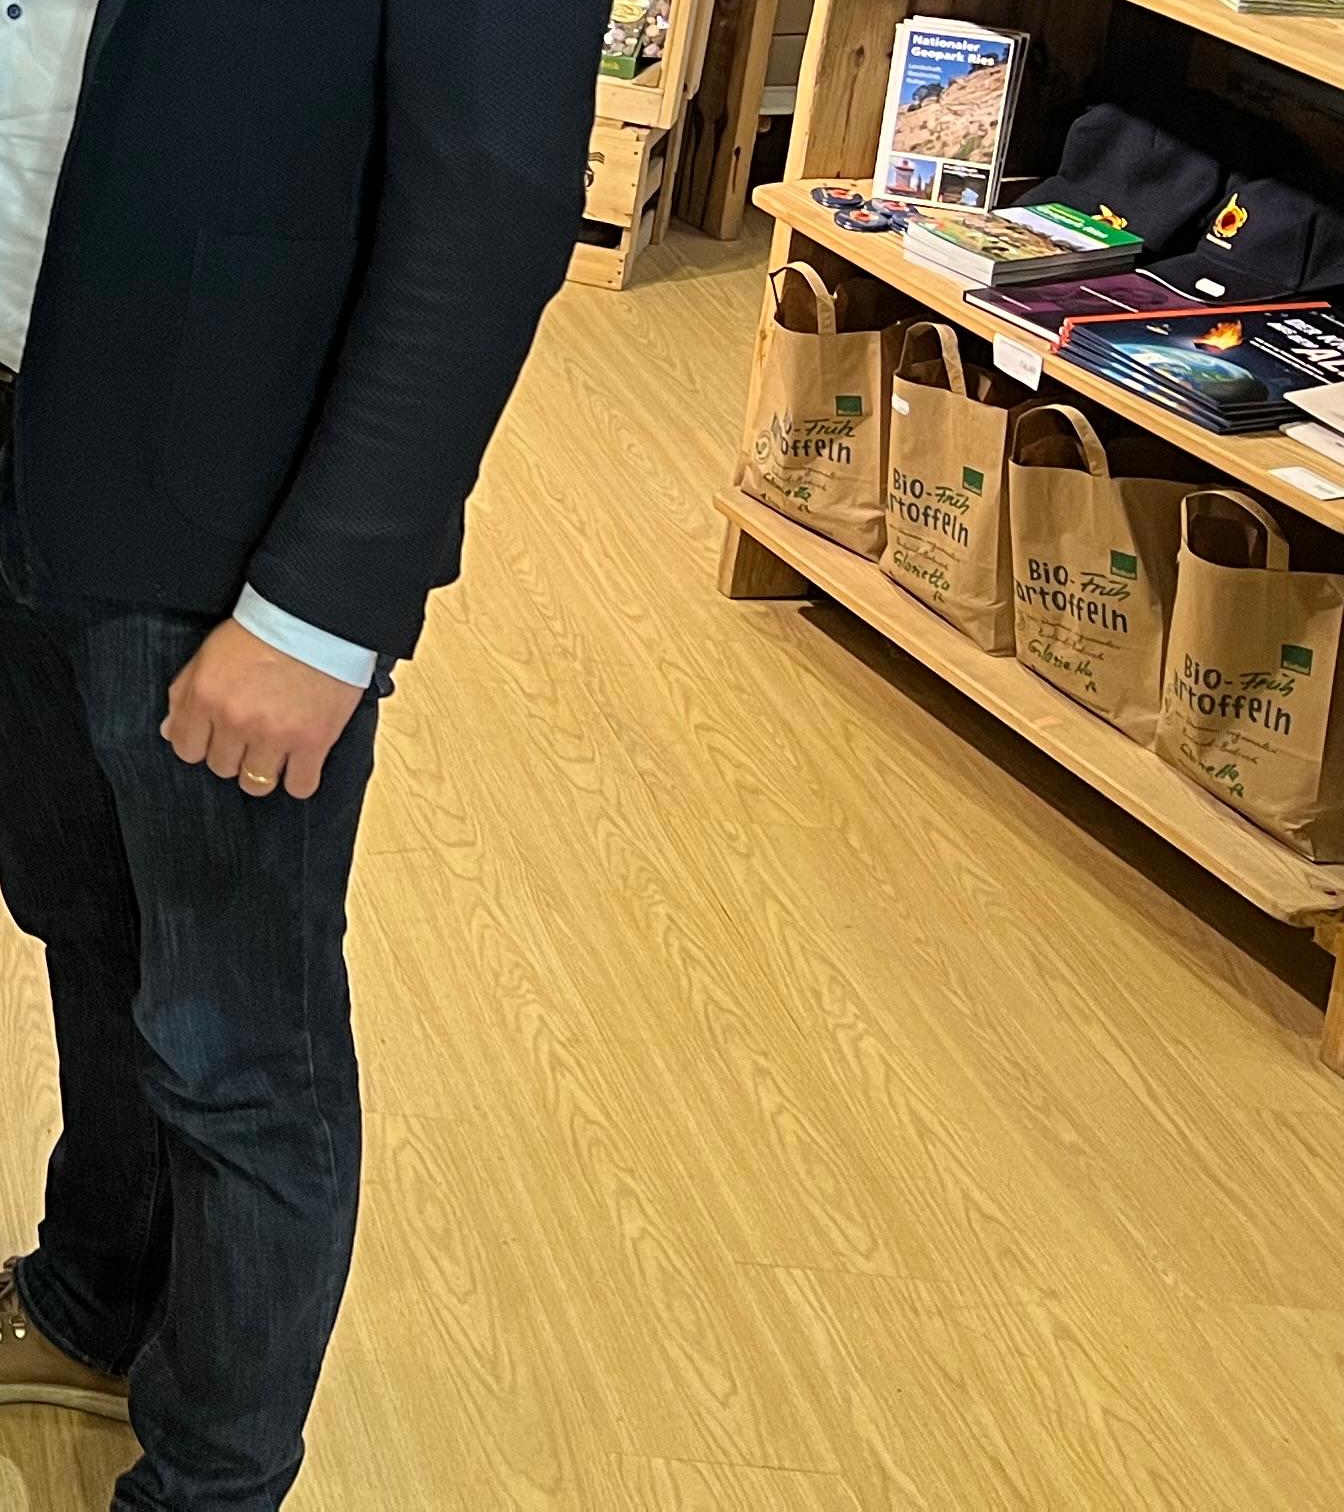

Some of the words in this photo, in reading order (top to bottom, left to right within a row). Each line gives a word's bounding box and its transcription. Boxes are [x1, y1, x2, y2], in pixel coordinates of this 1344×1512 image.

[911, 34, 981, 52] Nationaler
[910, 46, 964, 63] Geopark
[967, 53, 996, 67] Ries
[780, 436, 852, 465] offeln
[889, 493, 969, 548] rtoffeln
